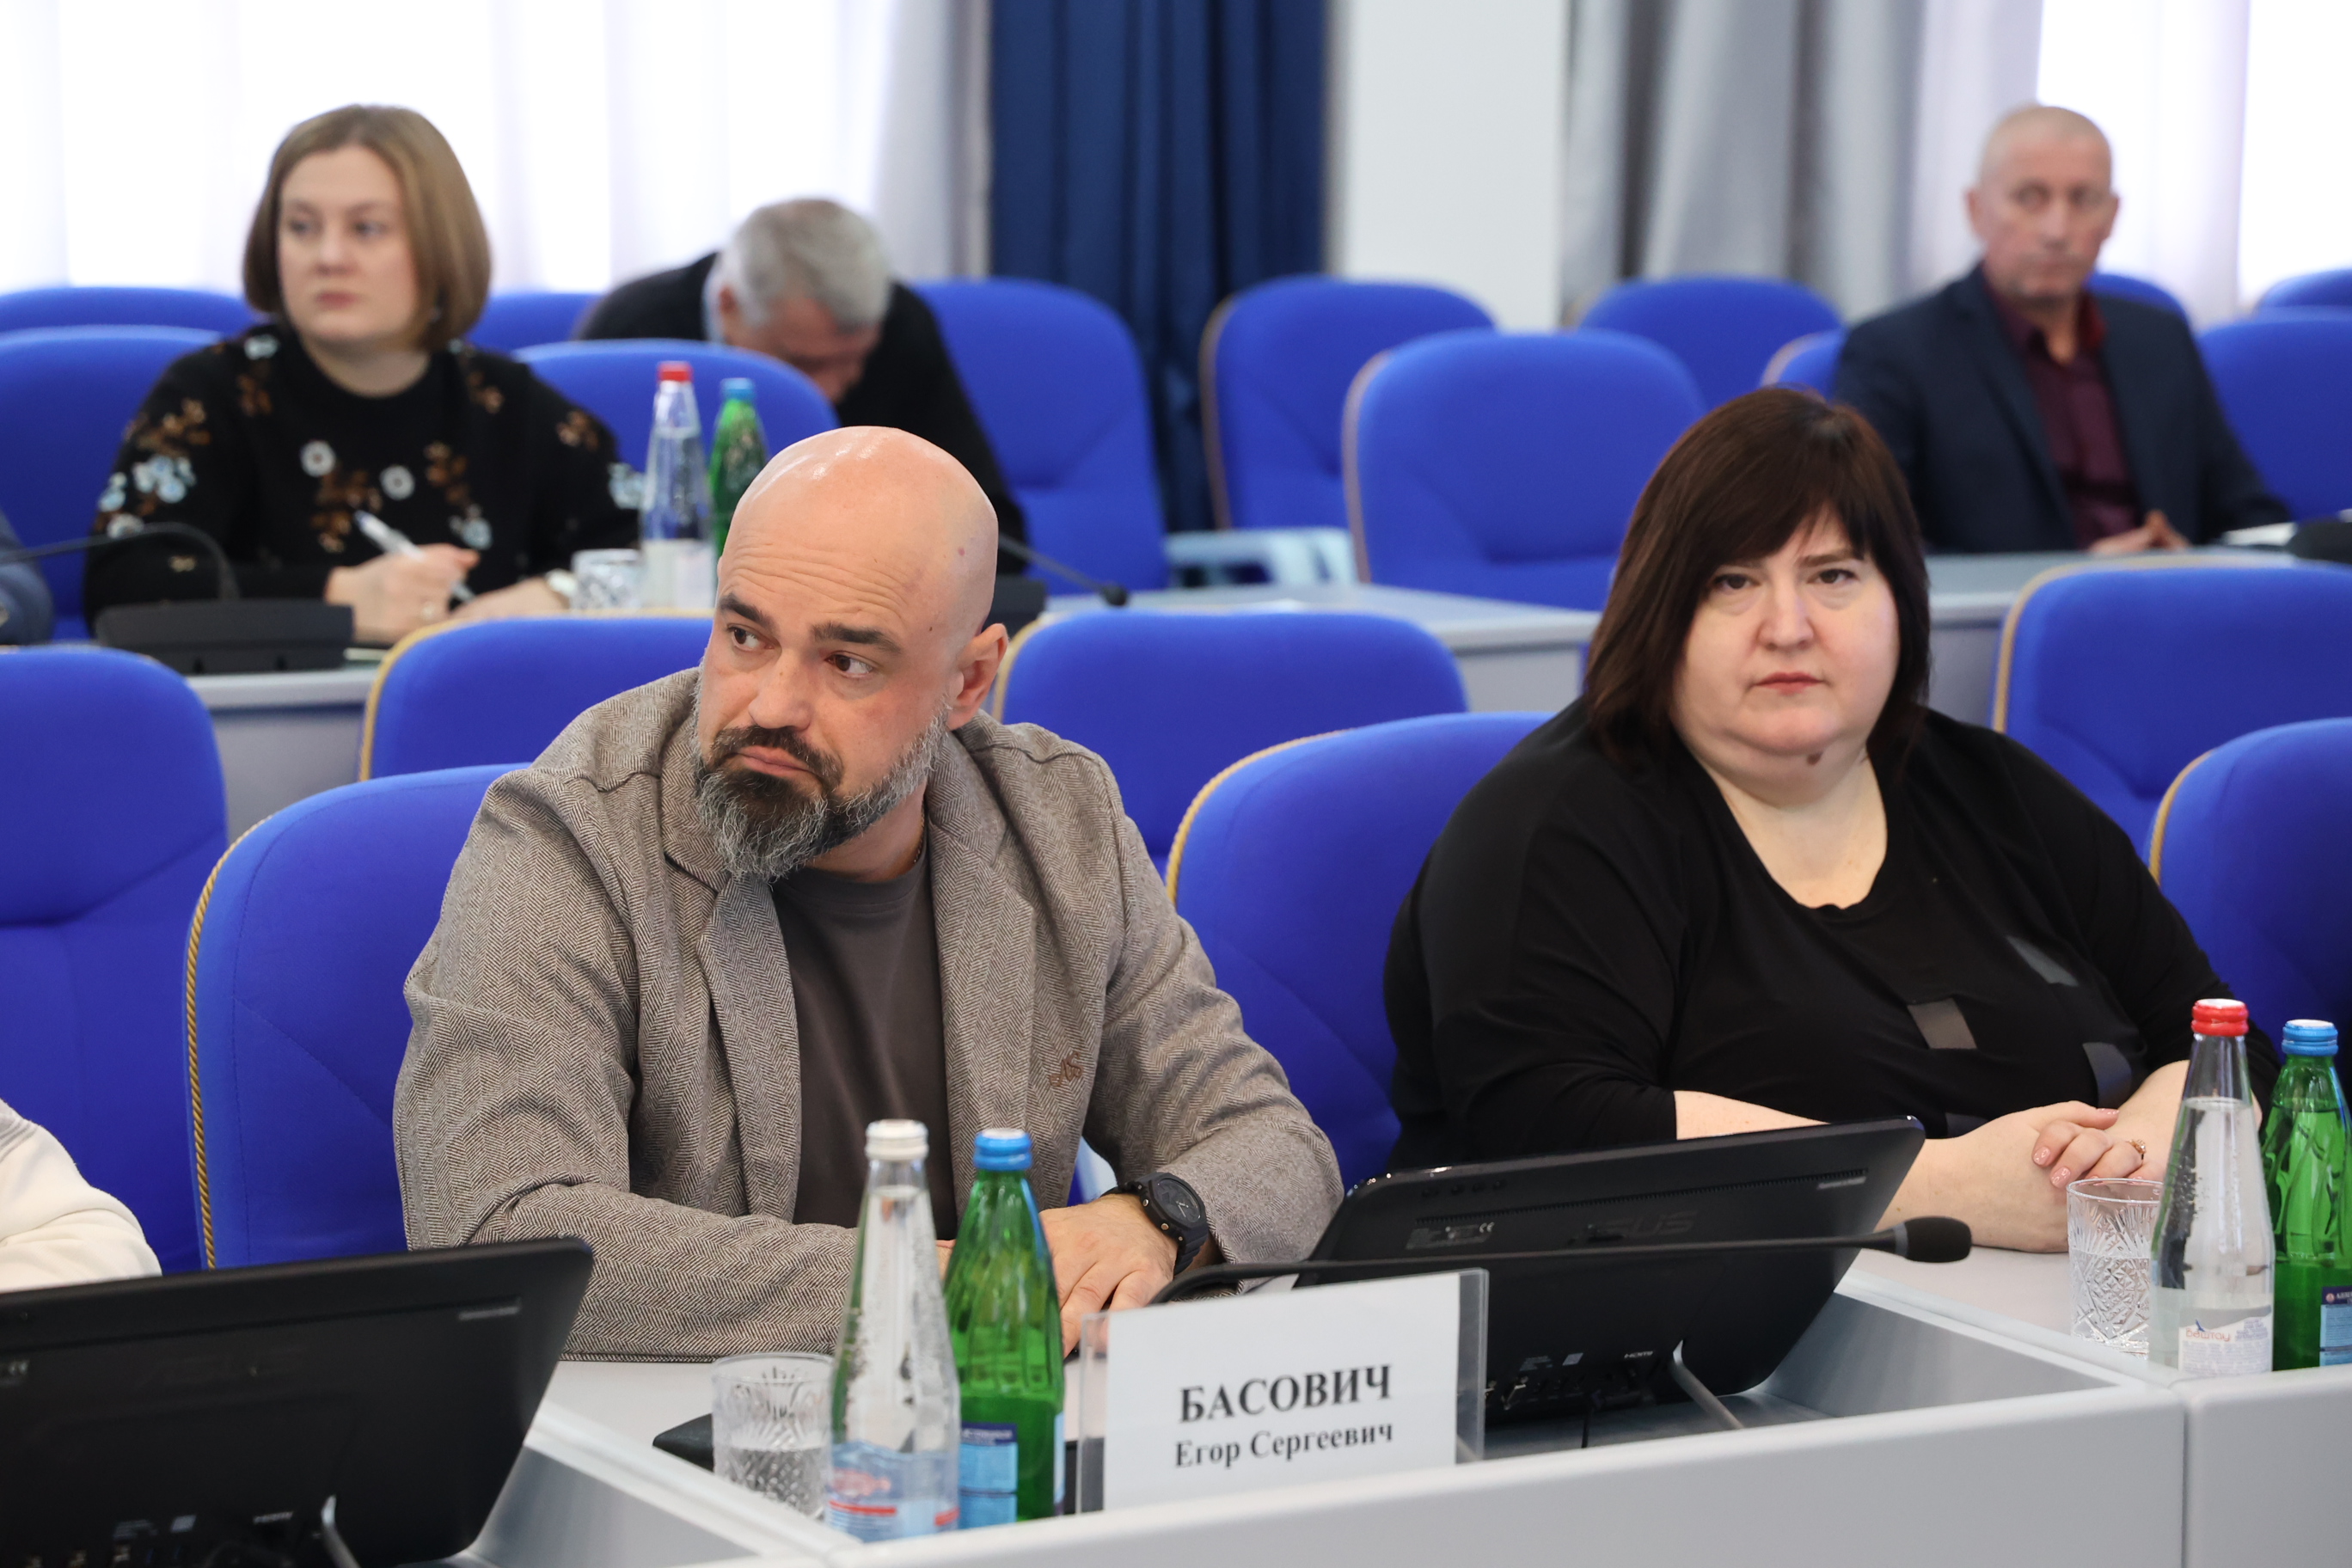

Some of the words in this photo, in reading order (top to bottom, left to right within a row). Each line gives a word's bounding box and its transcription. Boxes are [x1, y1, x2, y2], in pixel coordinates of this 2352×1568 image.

[1180, 1365, 1392, 1423] БАСОВИЧ
[1175, 1442, 1240, 1468] Егор
[1251, 1424, 1393, 1461] Сергеевич
